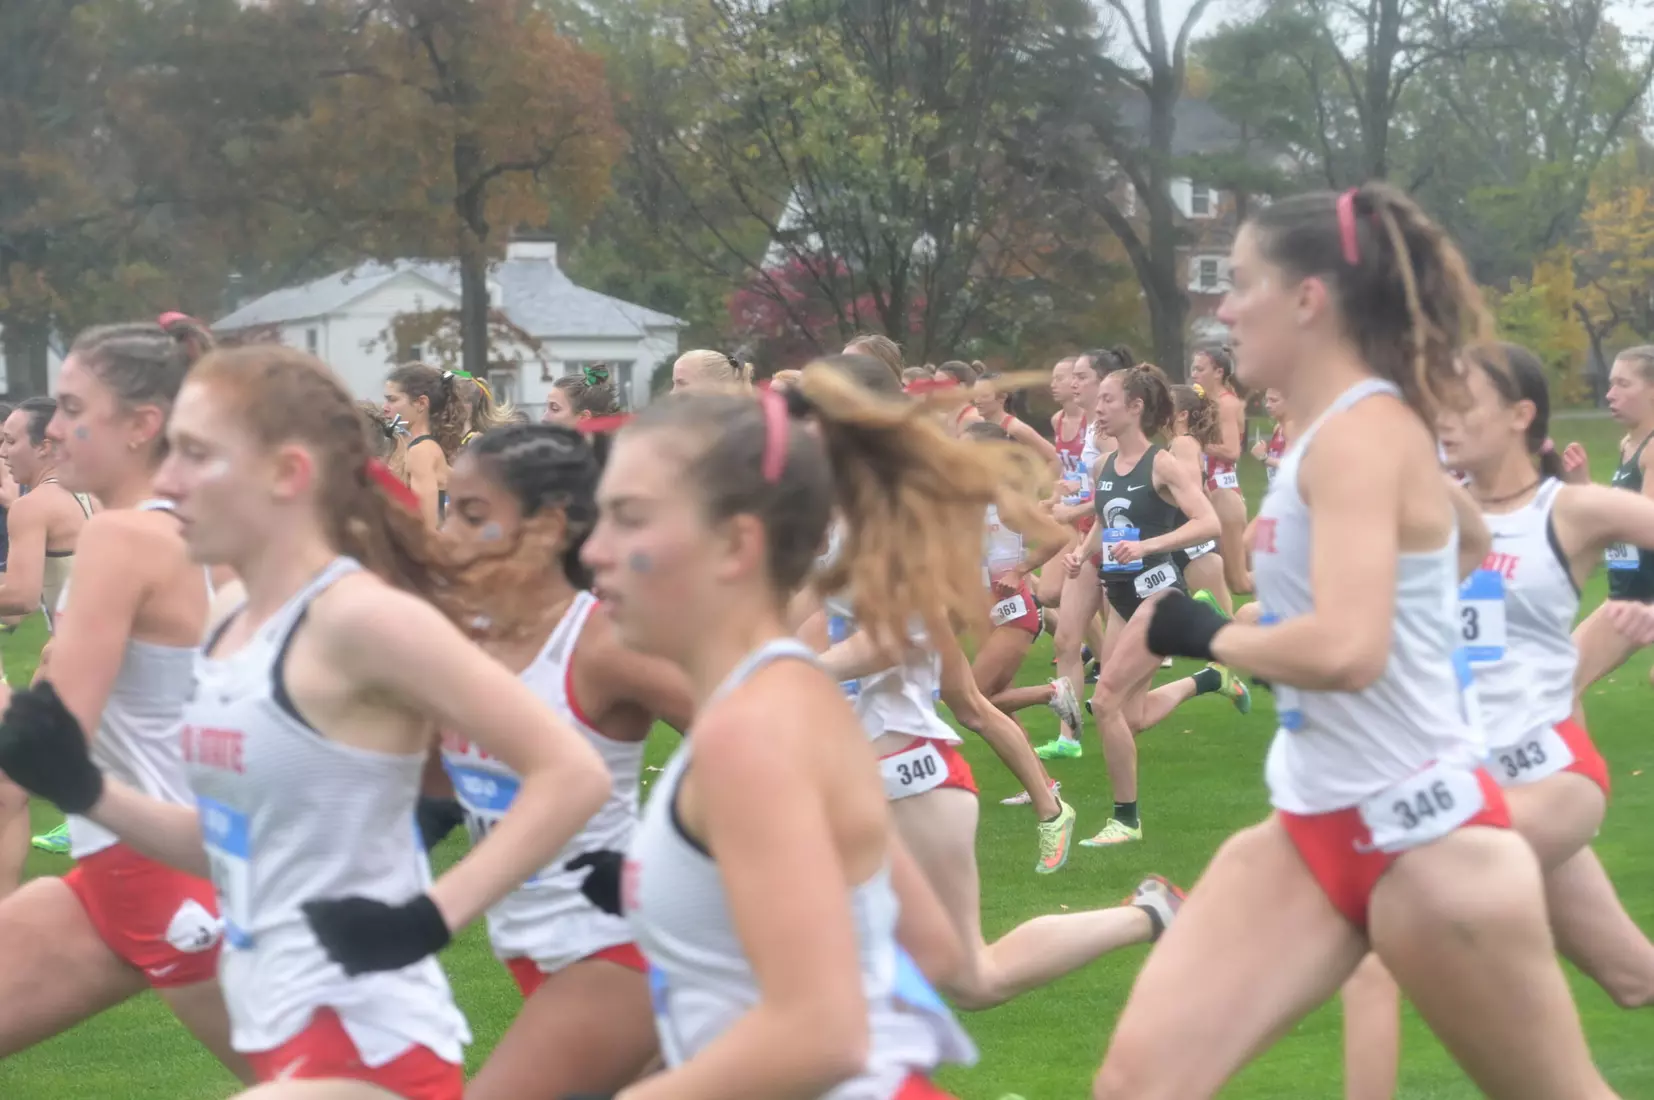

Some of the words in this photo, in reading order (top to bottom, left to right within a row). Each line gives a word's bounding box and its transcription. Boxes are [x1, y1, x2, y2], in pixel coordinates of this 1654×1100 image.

[1144, 570, 1167, 590] 300
[998, 602, 1017, 619] 369
[896, 754, 938, 786] 340
[1499, 740, 1548, 778] 343
[1391, 779, 1456, 831] 346
